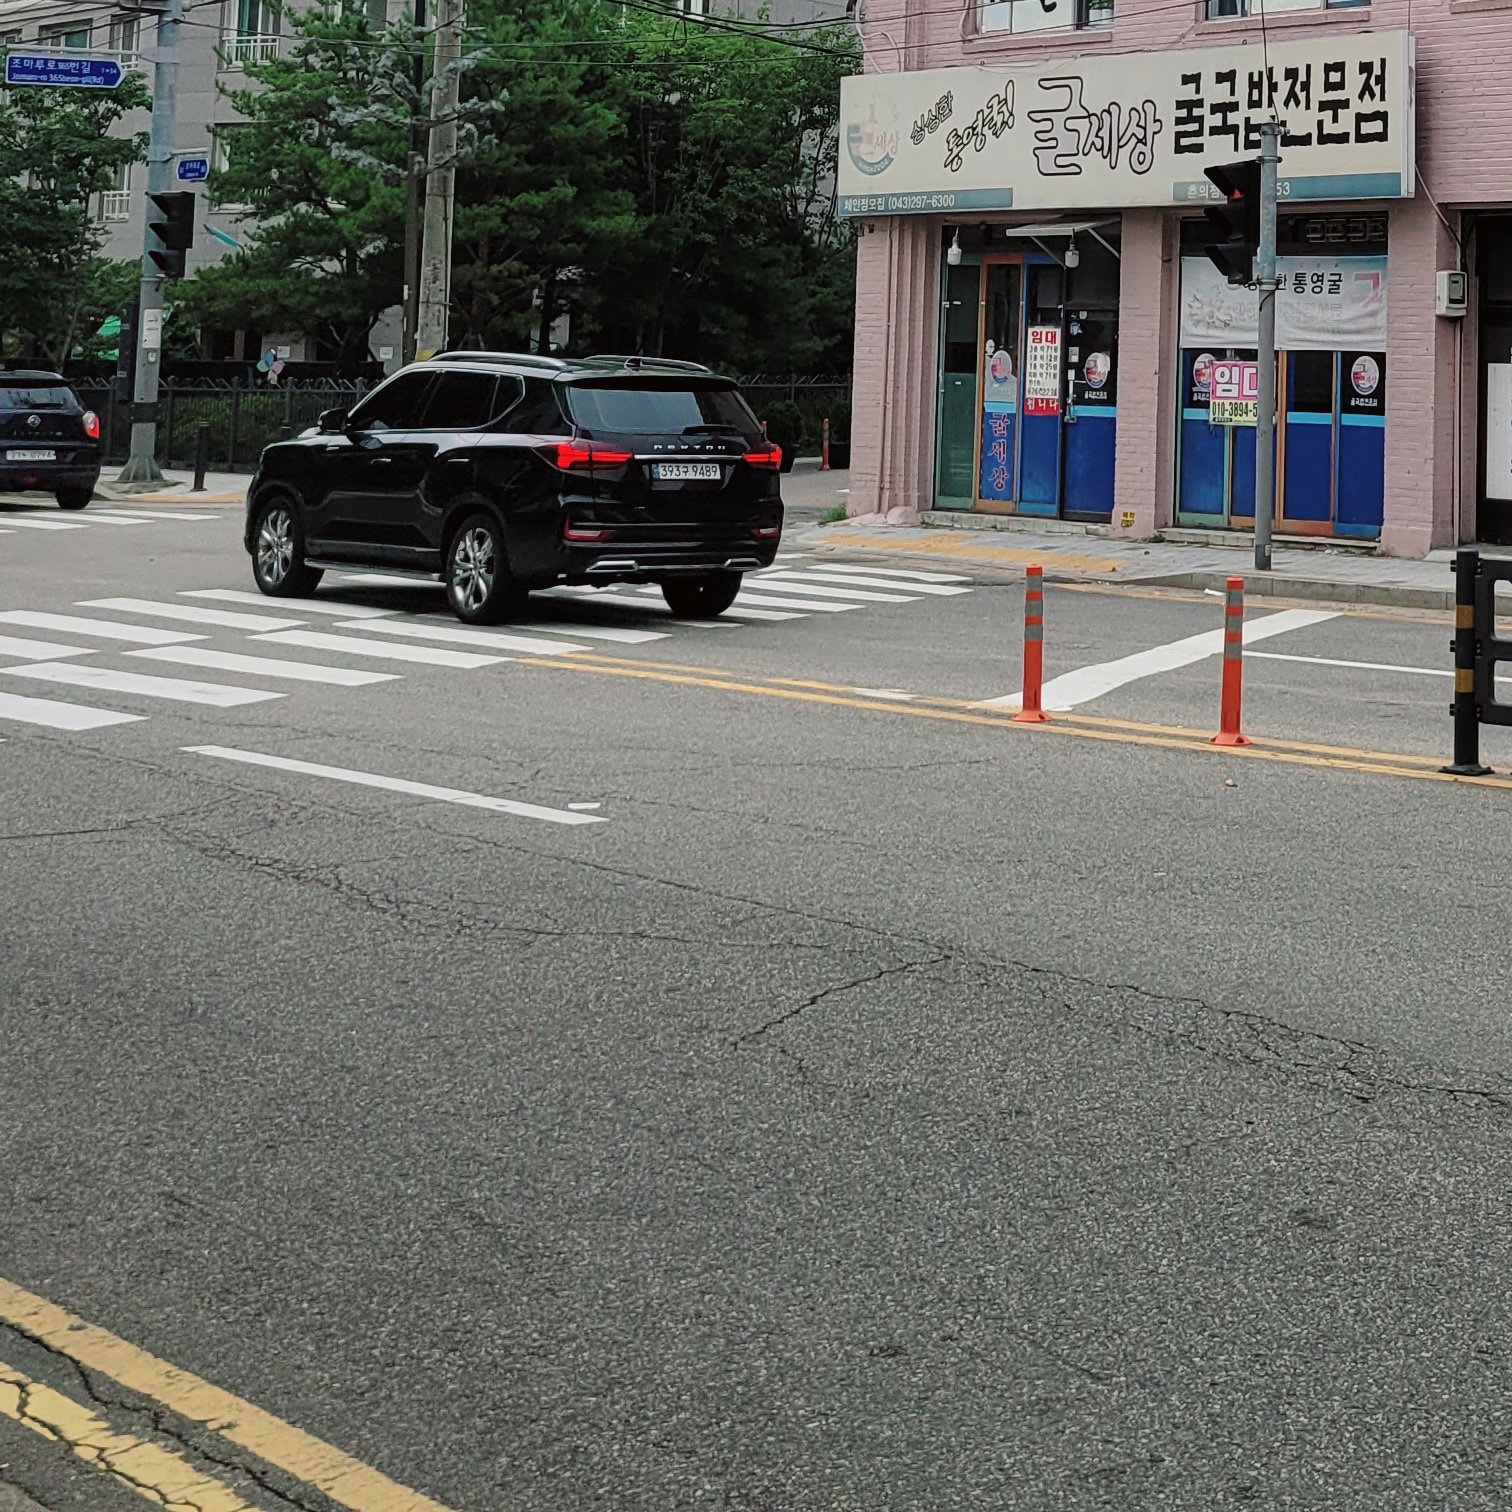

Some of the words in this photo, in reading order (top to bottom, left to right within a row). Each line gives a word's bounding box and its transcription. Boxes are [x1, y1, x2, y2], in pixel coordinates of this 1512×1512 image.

[888, 195, 955, 210] (043)297-6300
[1291, 272, 1344, 296] 통영굴
[1031, 330, 1057, 345] 임대
[1212, 401, 1258, 418] 010-3894-5
